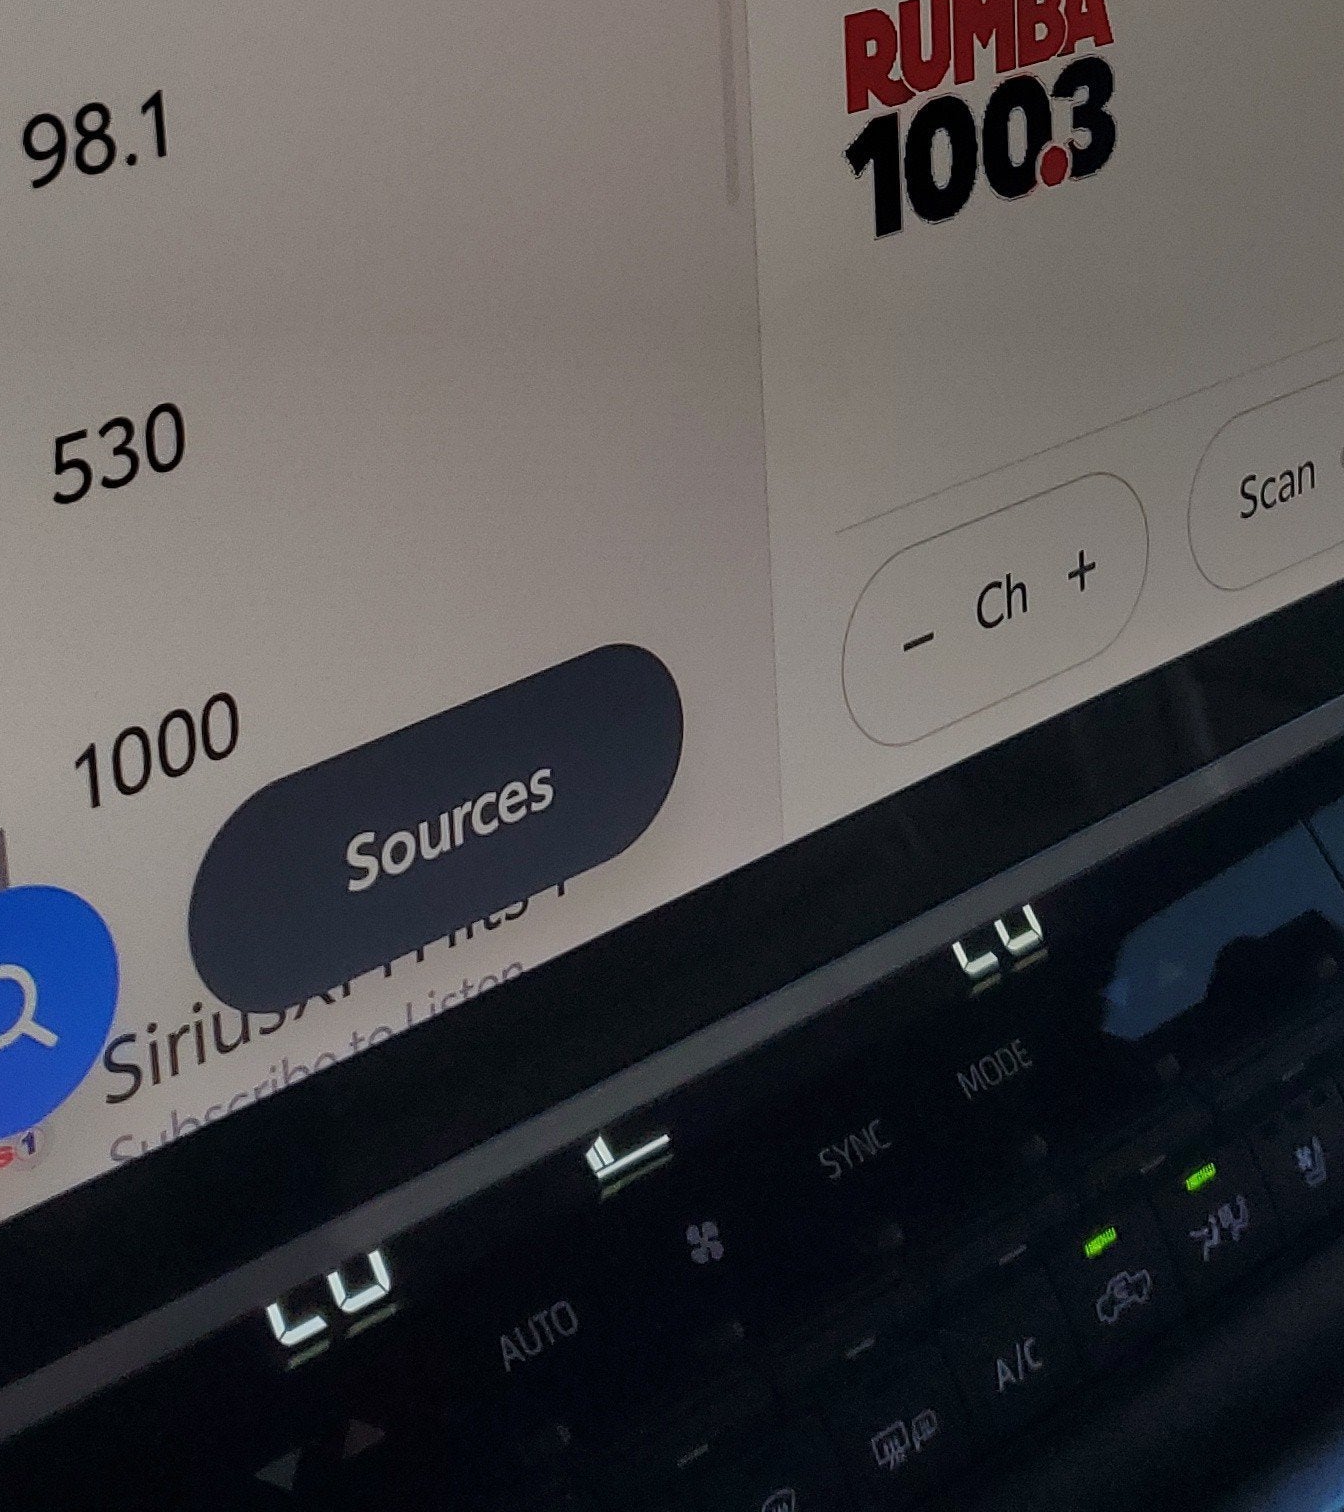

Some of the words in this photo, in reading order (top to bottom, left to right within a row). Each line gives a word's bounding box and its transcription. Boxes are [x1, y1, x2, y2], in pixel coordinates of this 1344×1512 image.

[21, 89, 168, 190] 98.1
[844, 54, 1118, 240] 100.3
[52, 402, 186, 505] 530
[1239, 454, 1316, 520] Scan
[976, 571, 1029, 630] Ch
[74, 691, 240, 810] 1000
[346, 765, 555, 892] Sources
[956, 1038, 1034, 1101] MODE
[817, 1118, 893, 1181] SYNC
[498, 1300, 581, 1373] AUTO
[995, 1336, 1045, 1393] A/C
